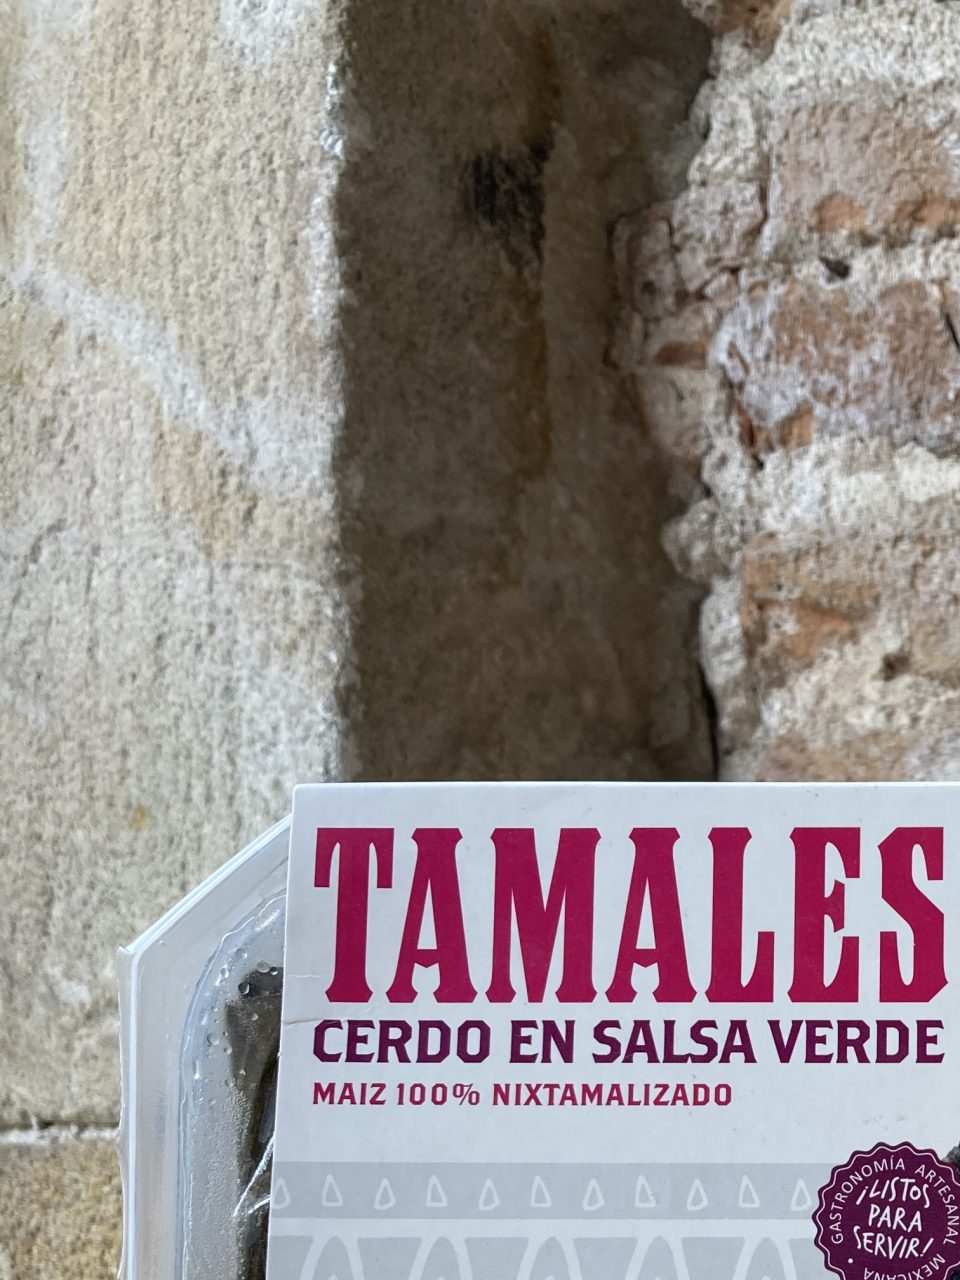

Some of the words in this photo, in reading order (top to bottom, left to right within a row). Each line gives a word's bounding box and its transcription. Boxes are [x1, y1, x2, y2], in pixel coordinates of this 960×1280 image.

[314, 826, 949, 1004] TAMALES
[313, 1019, 491, 1064] CERDO
[510, 1019, 575, 1064] EN
[592, 1019, 757, 1064] SALSA
[767, 1019, 945, 1064] VERDE
[313, 1082, 386, 1106] MAIZ
[396, 1082, 481, 1106] 100%
[492, 1082, 733, 1106] NIXTAMALIZADO
[868, 1203, 923, 1233] PARA
[914, 1164, 960, 1245] ARTESANAL
[853, 1225, 934, 1260] SERVIR!
